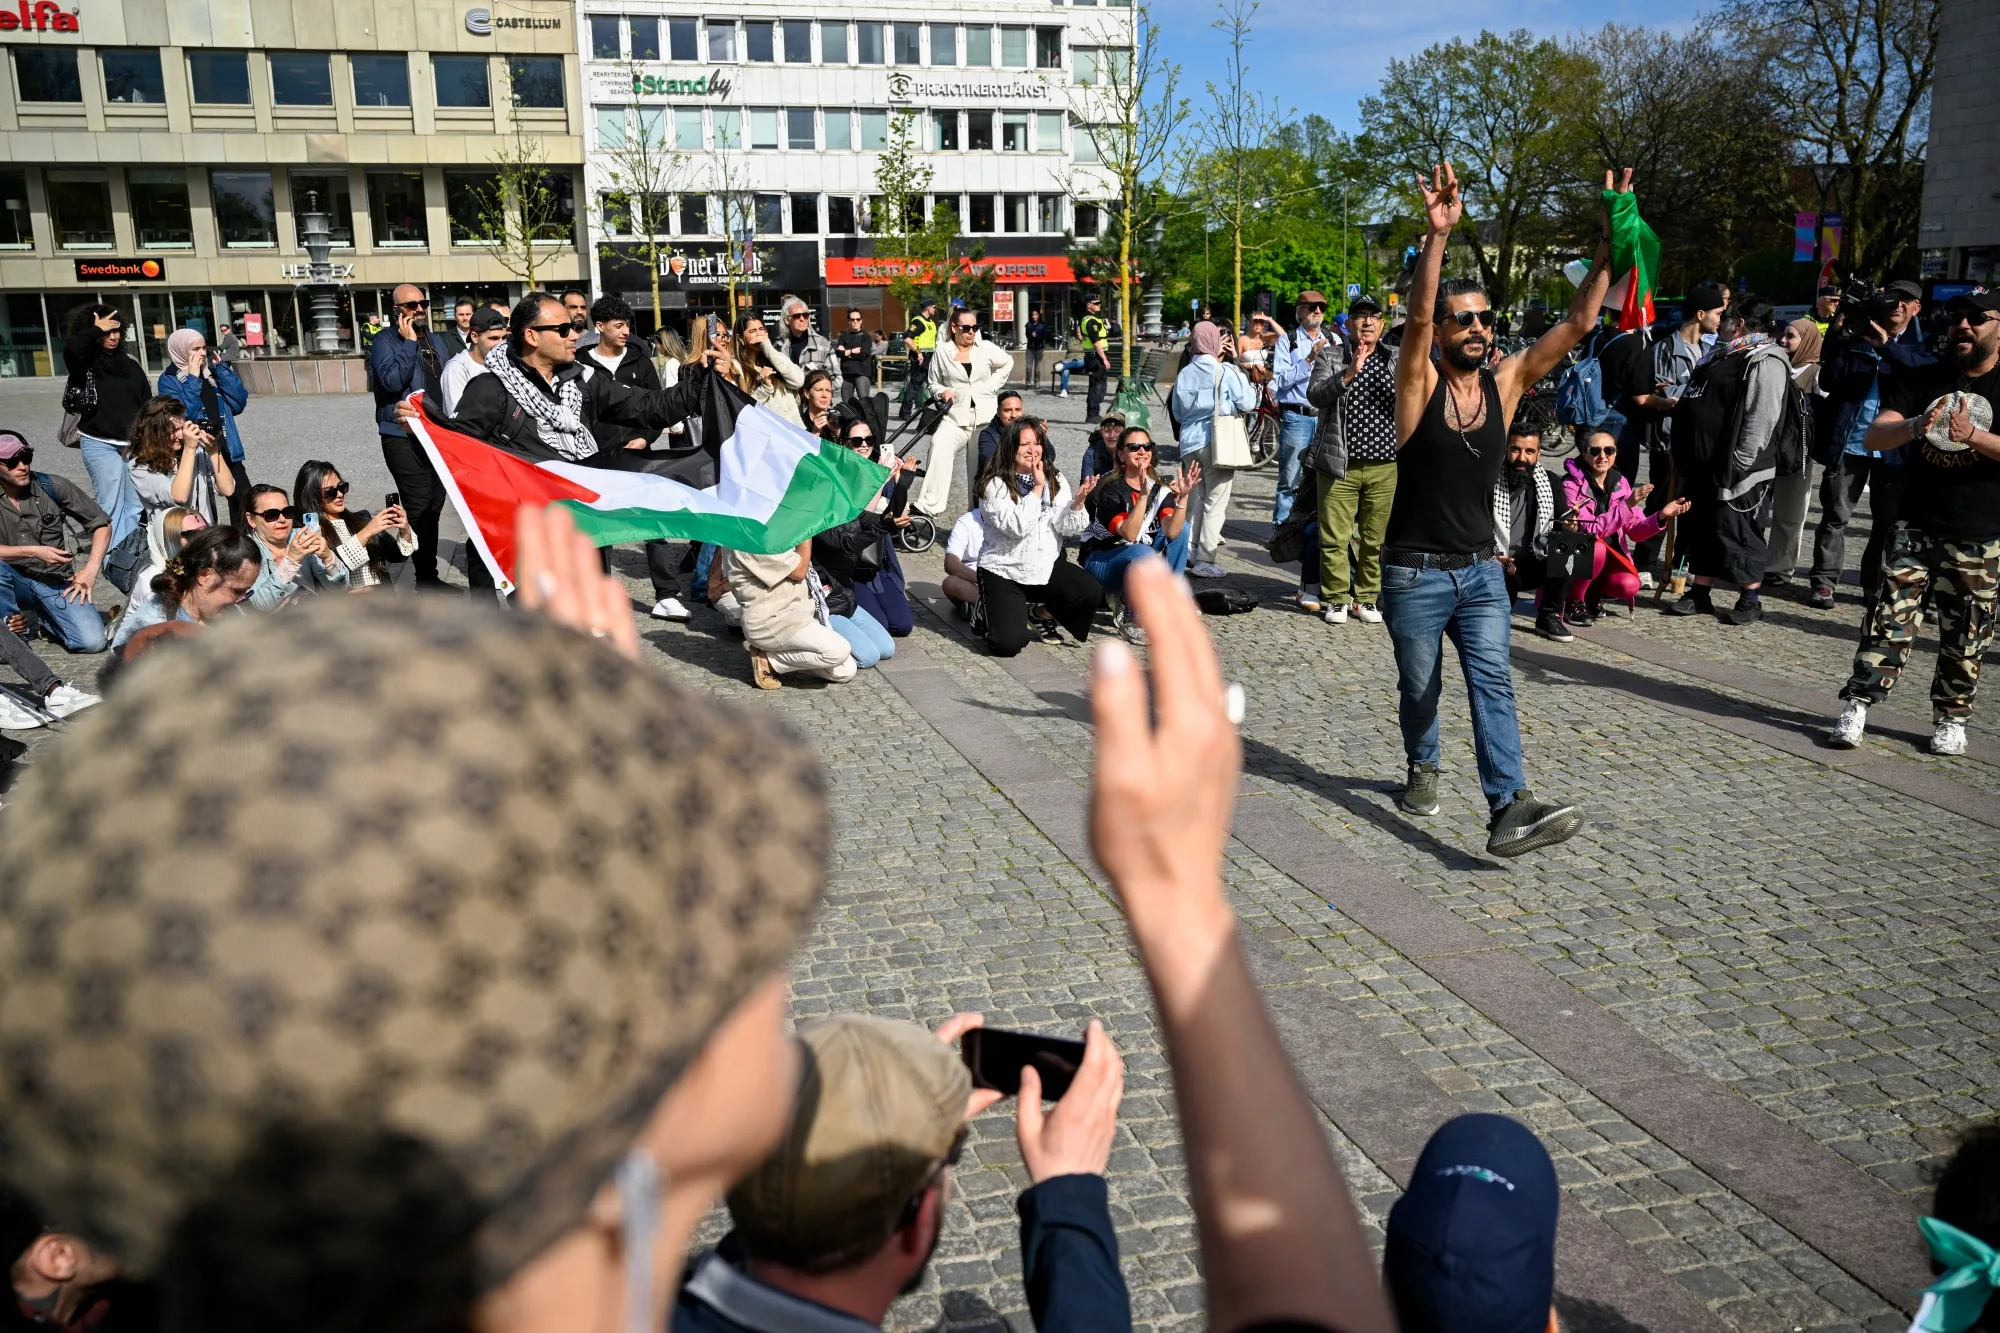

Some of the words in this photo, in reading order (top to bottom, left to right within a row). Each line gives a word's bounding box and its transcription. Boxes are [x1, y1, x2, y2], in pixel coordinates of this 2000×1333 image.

[496, 17, 561, 29] CASTELLUM
[915, 82, 1049, 98] PRAKTIKERTJÄNST
[80, 264, 141, 274] Swedbank
[281, 263, 355, 279] HEEX
[969, 263, 1047, 277] WOPPER
